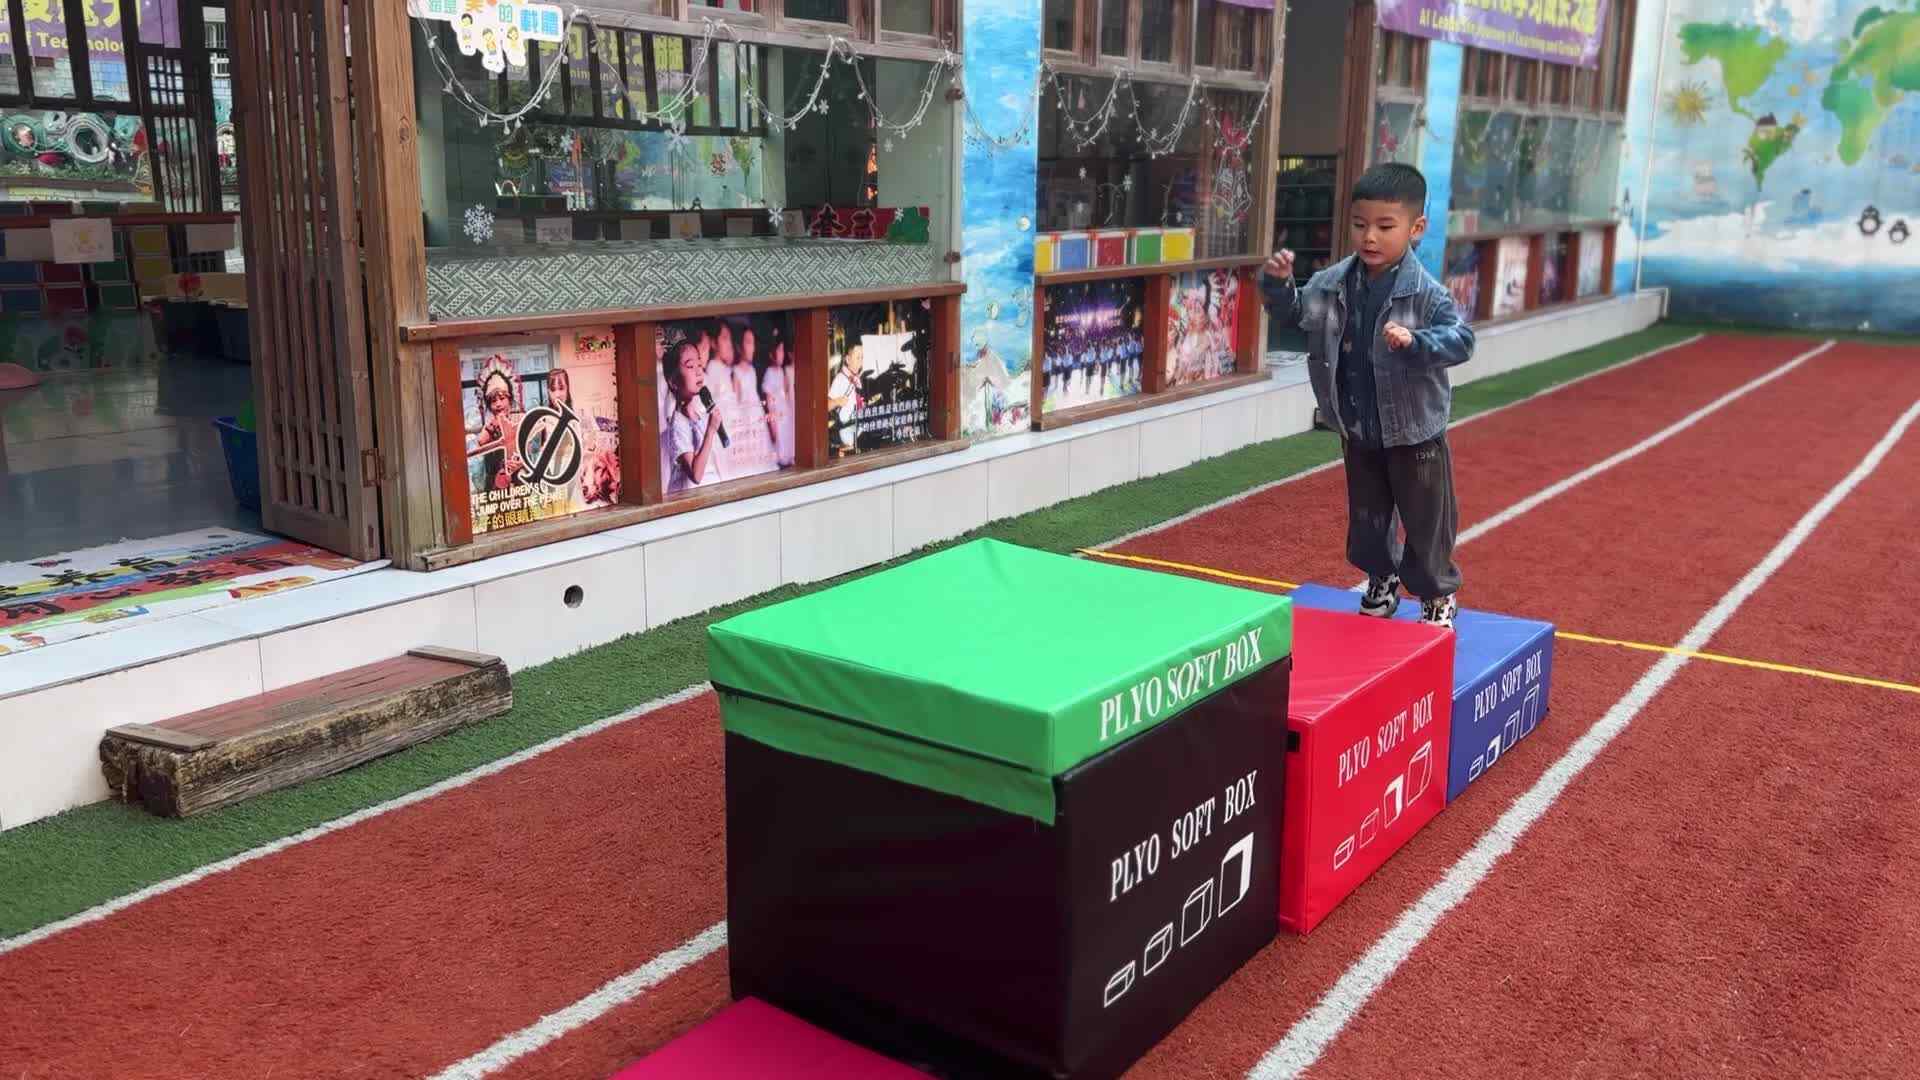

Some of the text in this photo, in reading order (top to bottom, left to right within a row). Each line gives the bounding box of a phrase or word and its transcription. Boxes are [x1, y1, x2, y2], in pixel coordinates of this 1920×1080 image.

[500, 498, 522, 512] OVER
[1099, 626, 1264, 741] PLYO SOFT BOX
[1474, 649, 1543, 723] PLYO SOFT BOX
[1338, 691, 1435, 789] PLYO SOFT BOX
[1109, 769, 1258, 903] PLYO SOFT BOX
